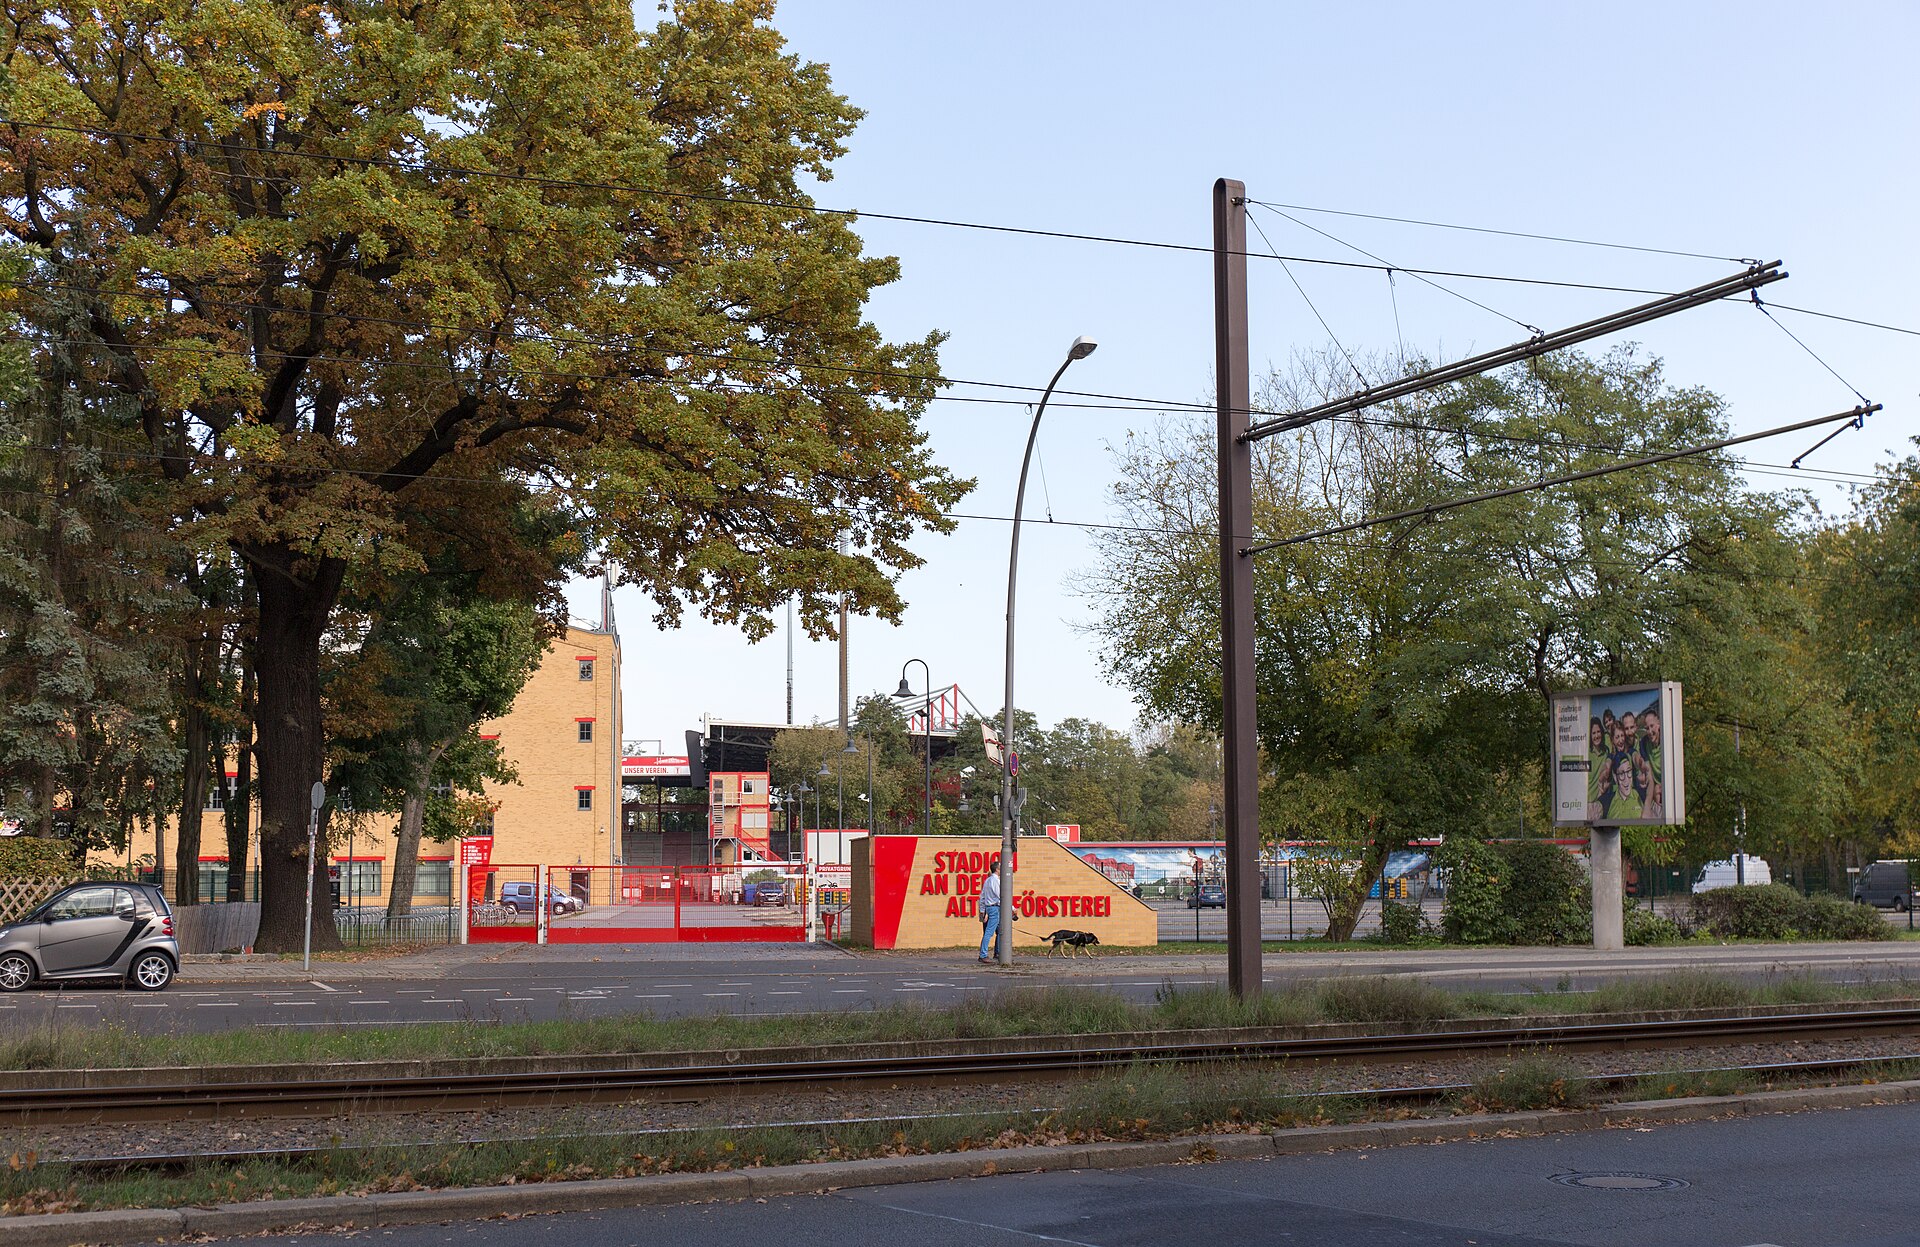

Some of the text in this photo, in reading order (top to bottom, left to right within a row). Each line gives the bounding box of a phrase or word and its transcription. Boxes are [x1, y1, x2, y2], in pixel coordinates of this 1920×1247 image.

[920, 874, 948, 895] AN
[945, 890, 1111, 918] ALT FÖRSTEREI
